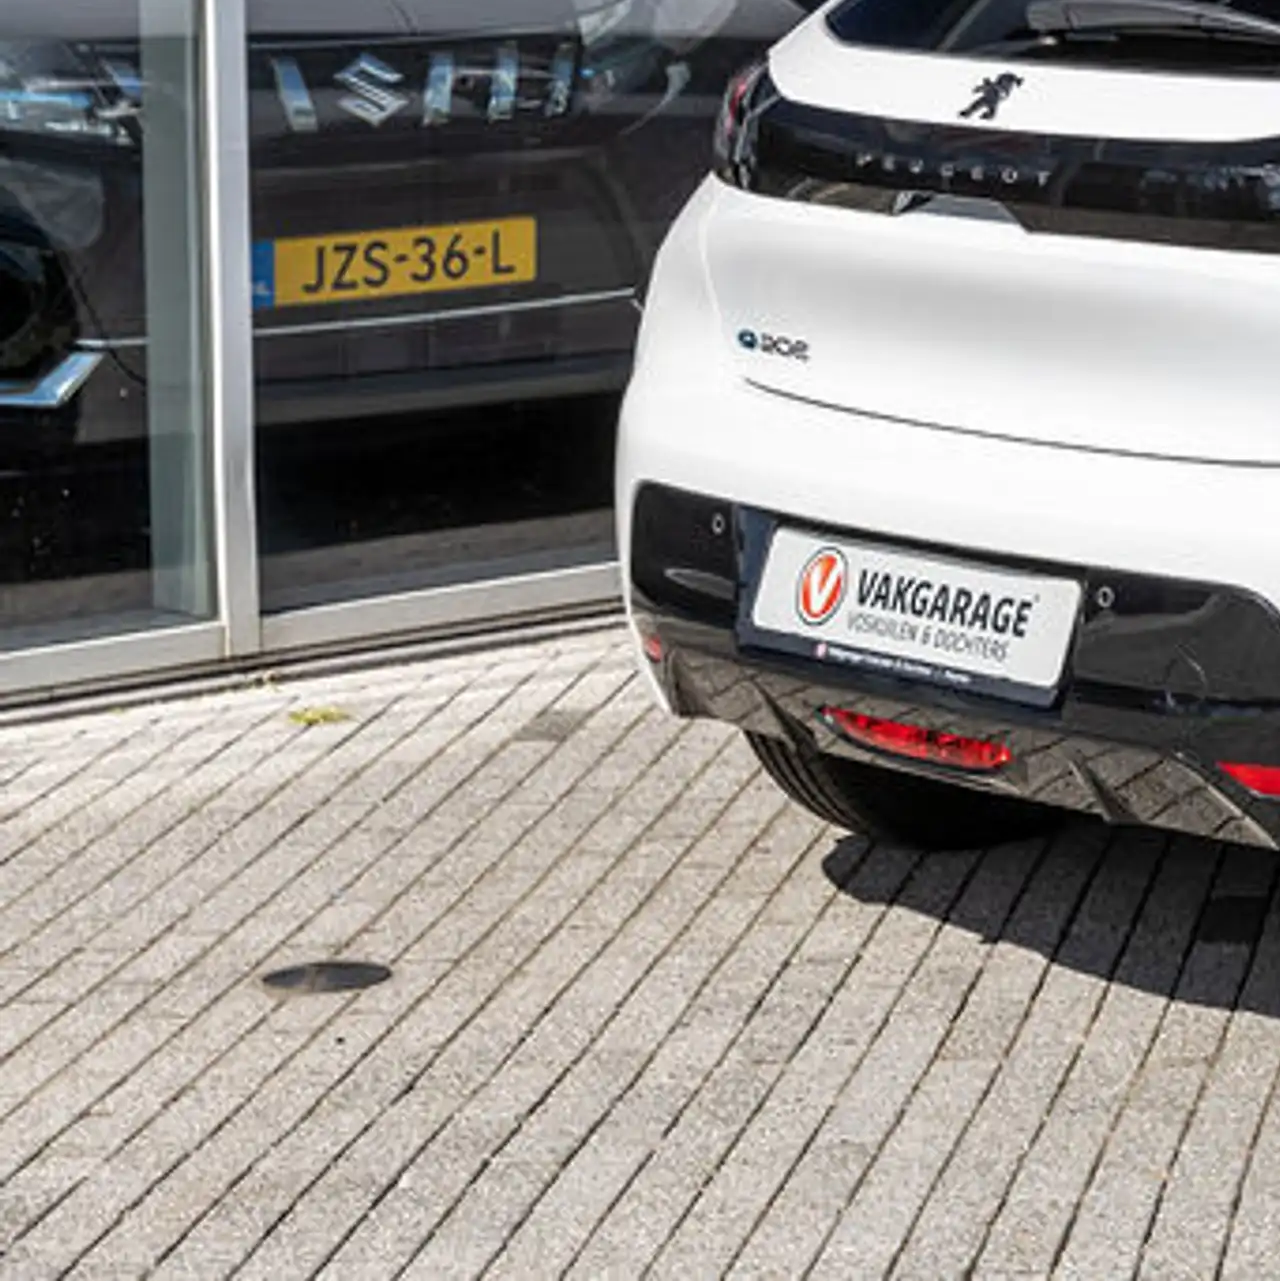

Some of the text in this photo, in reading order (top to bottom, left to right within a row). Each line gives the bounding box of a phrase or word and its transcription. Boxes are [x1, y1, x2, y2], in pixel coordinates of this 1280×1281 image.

[856, 152, 1050, 186] PEUGEOT
[302, 230, 516, 293] JZS-36-L
[857, 569, 1032, 638] VAKGARAGE
[934, 627, 1009, 662] DOCHTERS
